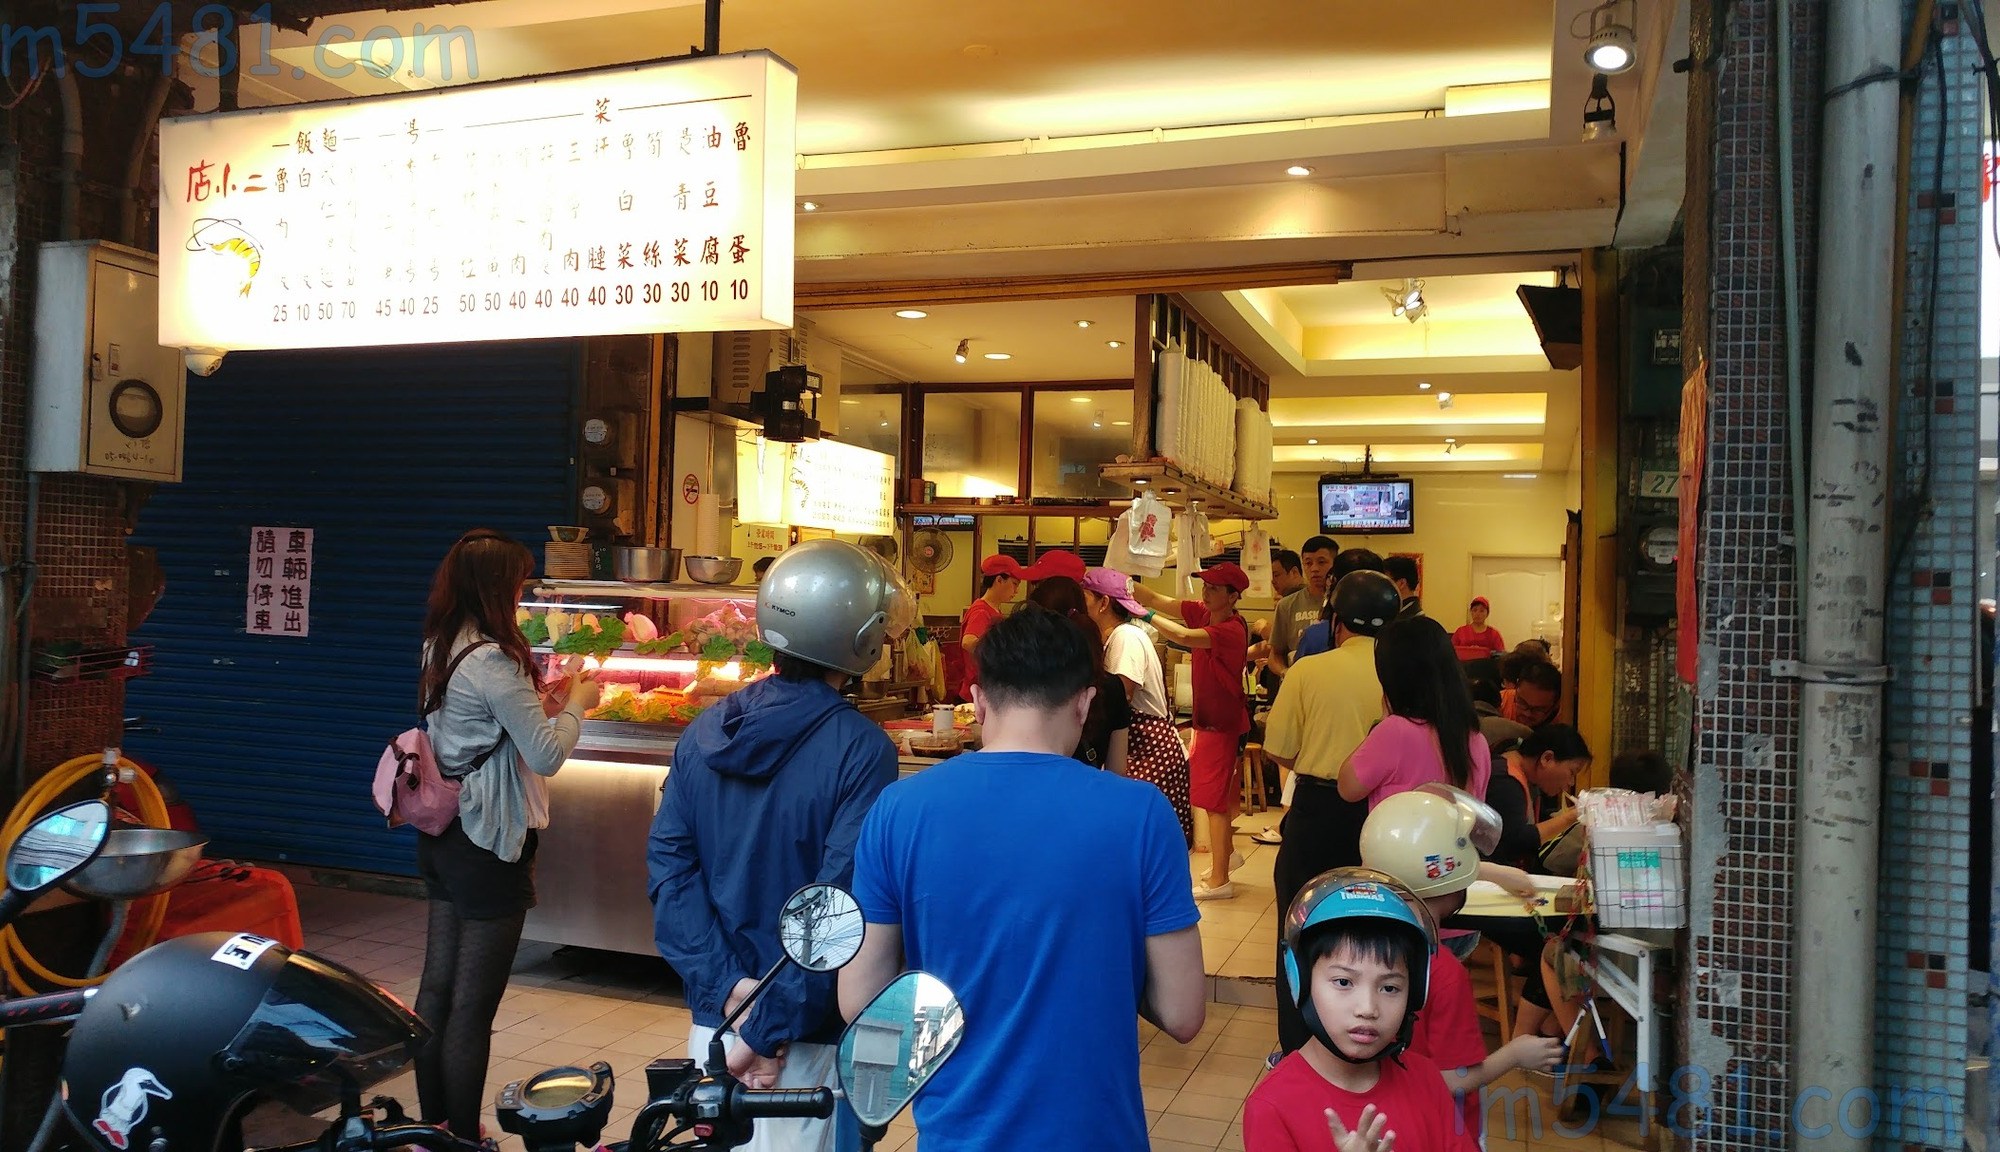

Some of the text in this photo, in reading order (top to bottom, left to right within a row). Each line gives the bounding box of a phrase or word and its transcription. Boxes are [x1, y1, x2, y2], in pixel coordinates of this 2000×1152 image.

[594, 97, 612, 124] 菜
[698, 123, 721, 268] 油豆腐
[728, 121, 751, 265] 魯蛋
[273, 278, 749, 322] 25 10 50 70 45 40 25 50 50 40 40 40 40 30 30 30 10 10
[1651, 474, 1679, 493] 27
[252, 529, 276, 632] 請勿停車
[280, 529, 308, 633] 車輛進出
[771, 604, 796, 617] KYMCO
